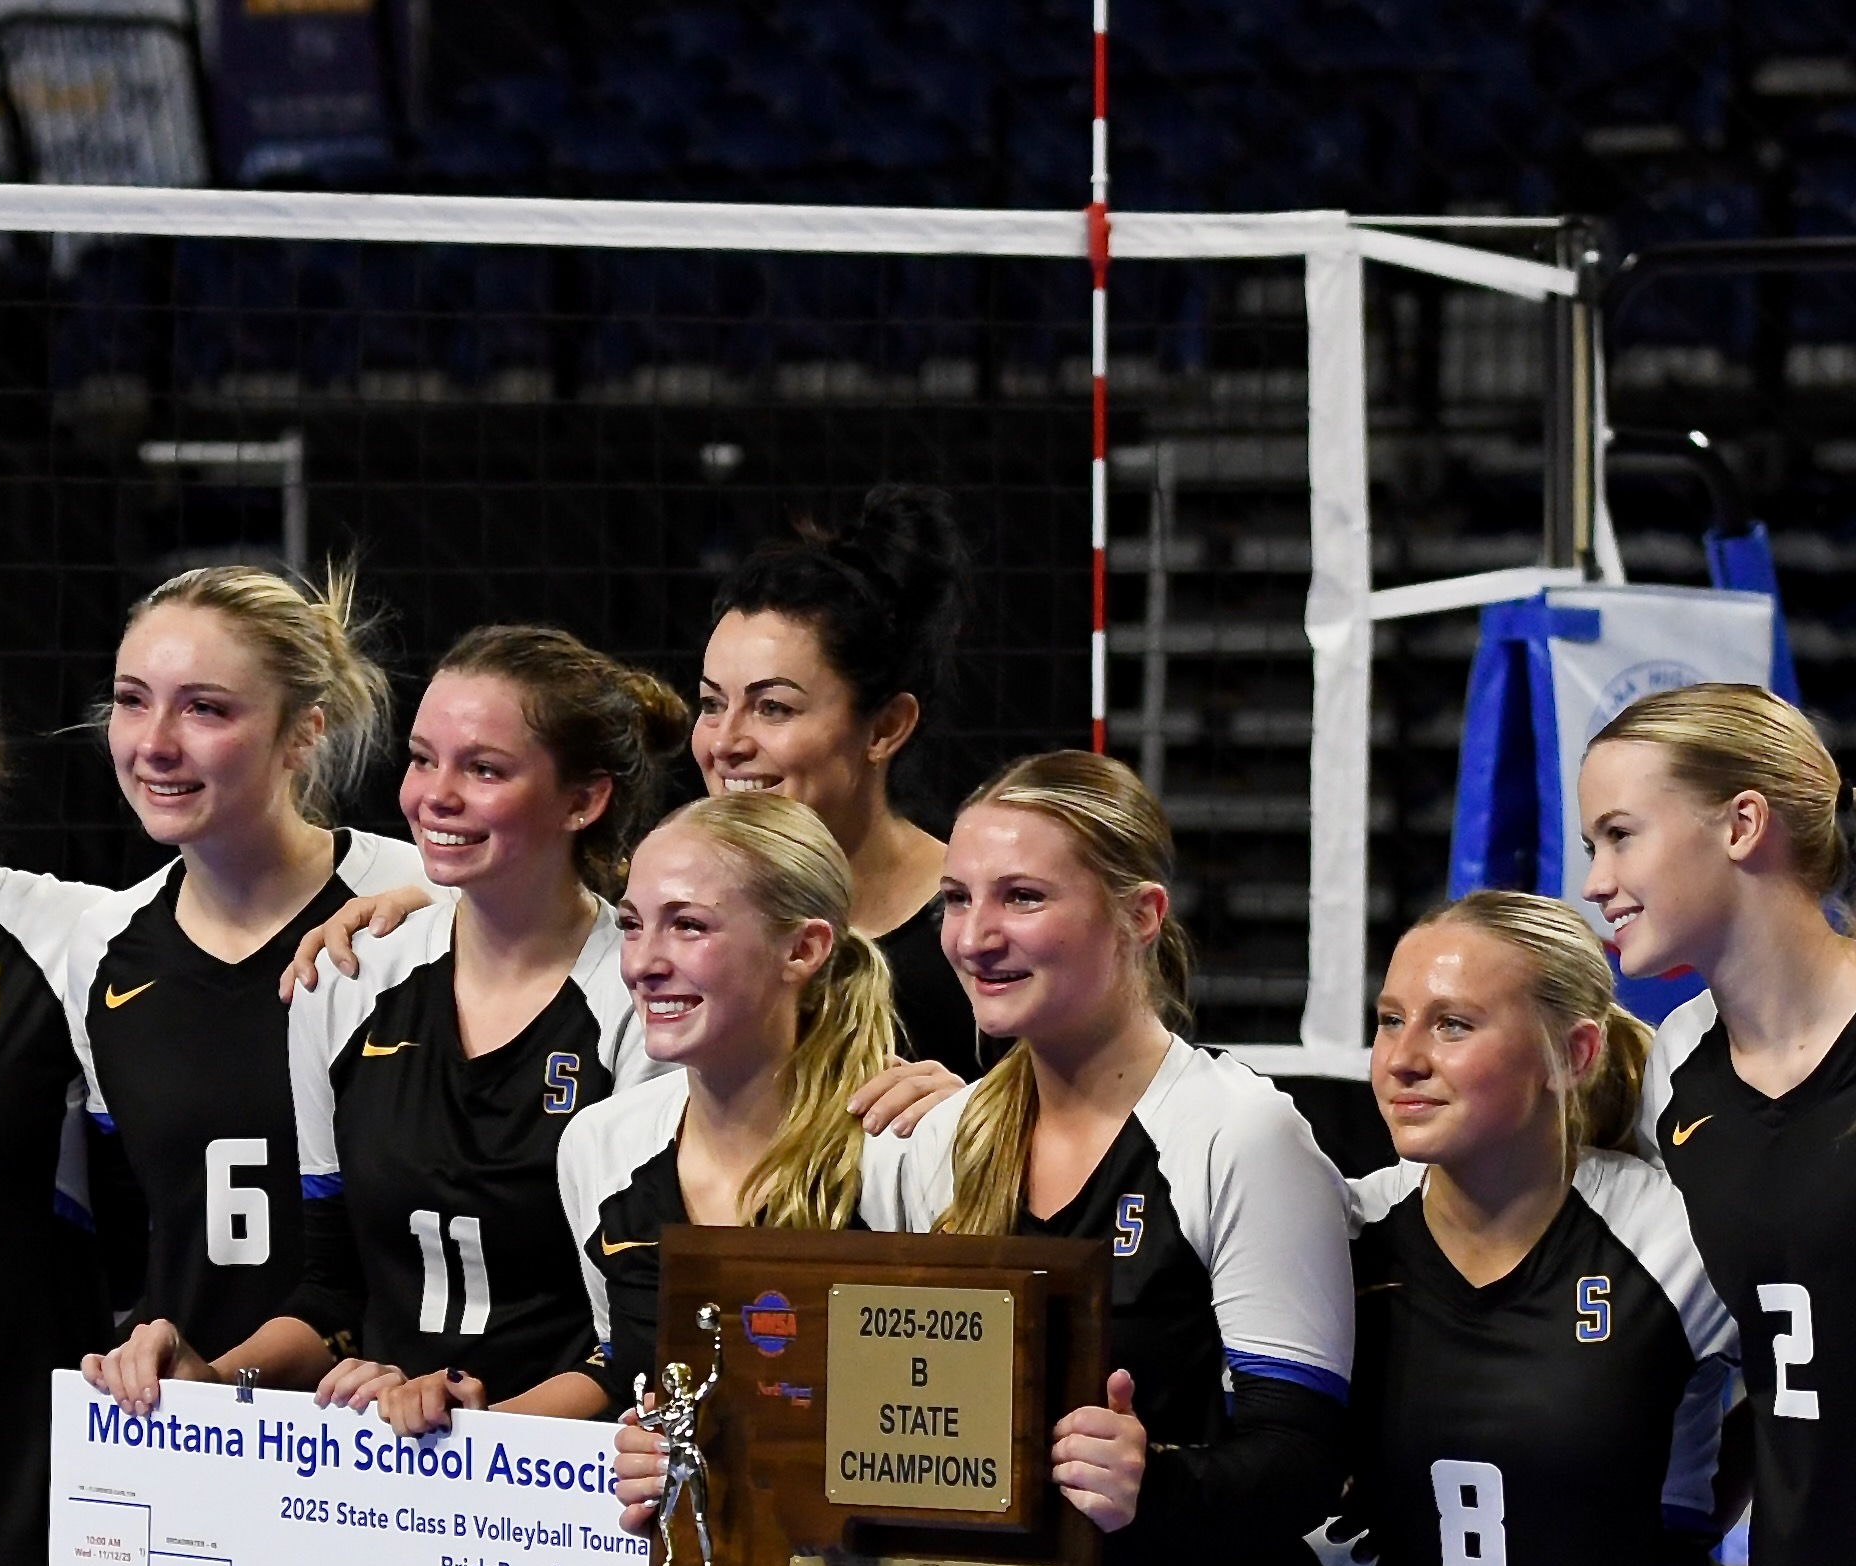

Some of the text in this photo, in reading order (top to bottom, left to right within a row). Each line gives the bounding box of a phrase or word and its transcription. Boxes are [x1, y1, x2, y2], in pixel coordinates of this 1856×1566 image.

[542, 1051, 580, 1114] S
[205, 1138, 270, 1266] 6
[1111, 1192, 1146, 1258] S
[409, 1208, 492, 1336] 11
[858, 1306, 984, 1343] 2025-2026
[1574, 1275, 1613, 1344] S
[910, 1357, 929, 1388] B
[1756, 1283, 1820, 1421] 2
[88, 1402, 244, 1458] Montana
[258, 1419, 339, 1478] High
[354, 1428, 473, 1481] School
[879, 1403, 960, 1438] STATE
[839, 1450, 998, 1489] CHAMPIONS
[74, 1547, 92, 1558] Wed
[107, 1538, 121, 1548] AM
[280, 1496, 329, 1524] 2025
[335, 1501, 389, 1530] State
[395, 1507, 447, 1535] Class
[453, 1513, 467, 1537] B
[472, 1515, 572, 1551] Volleyball
